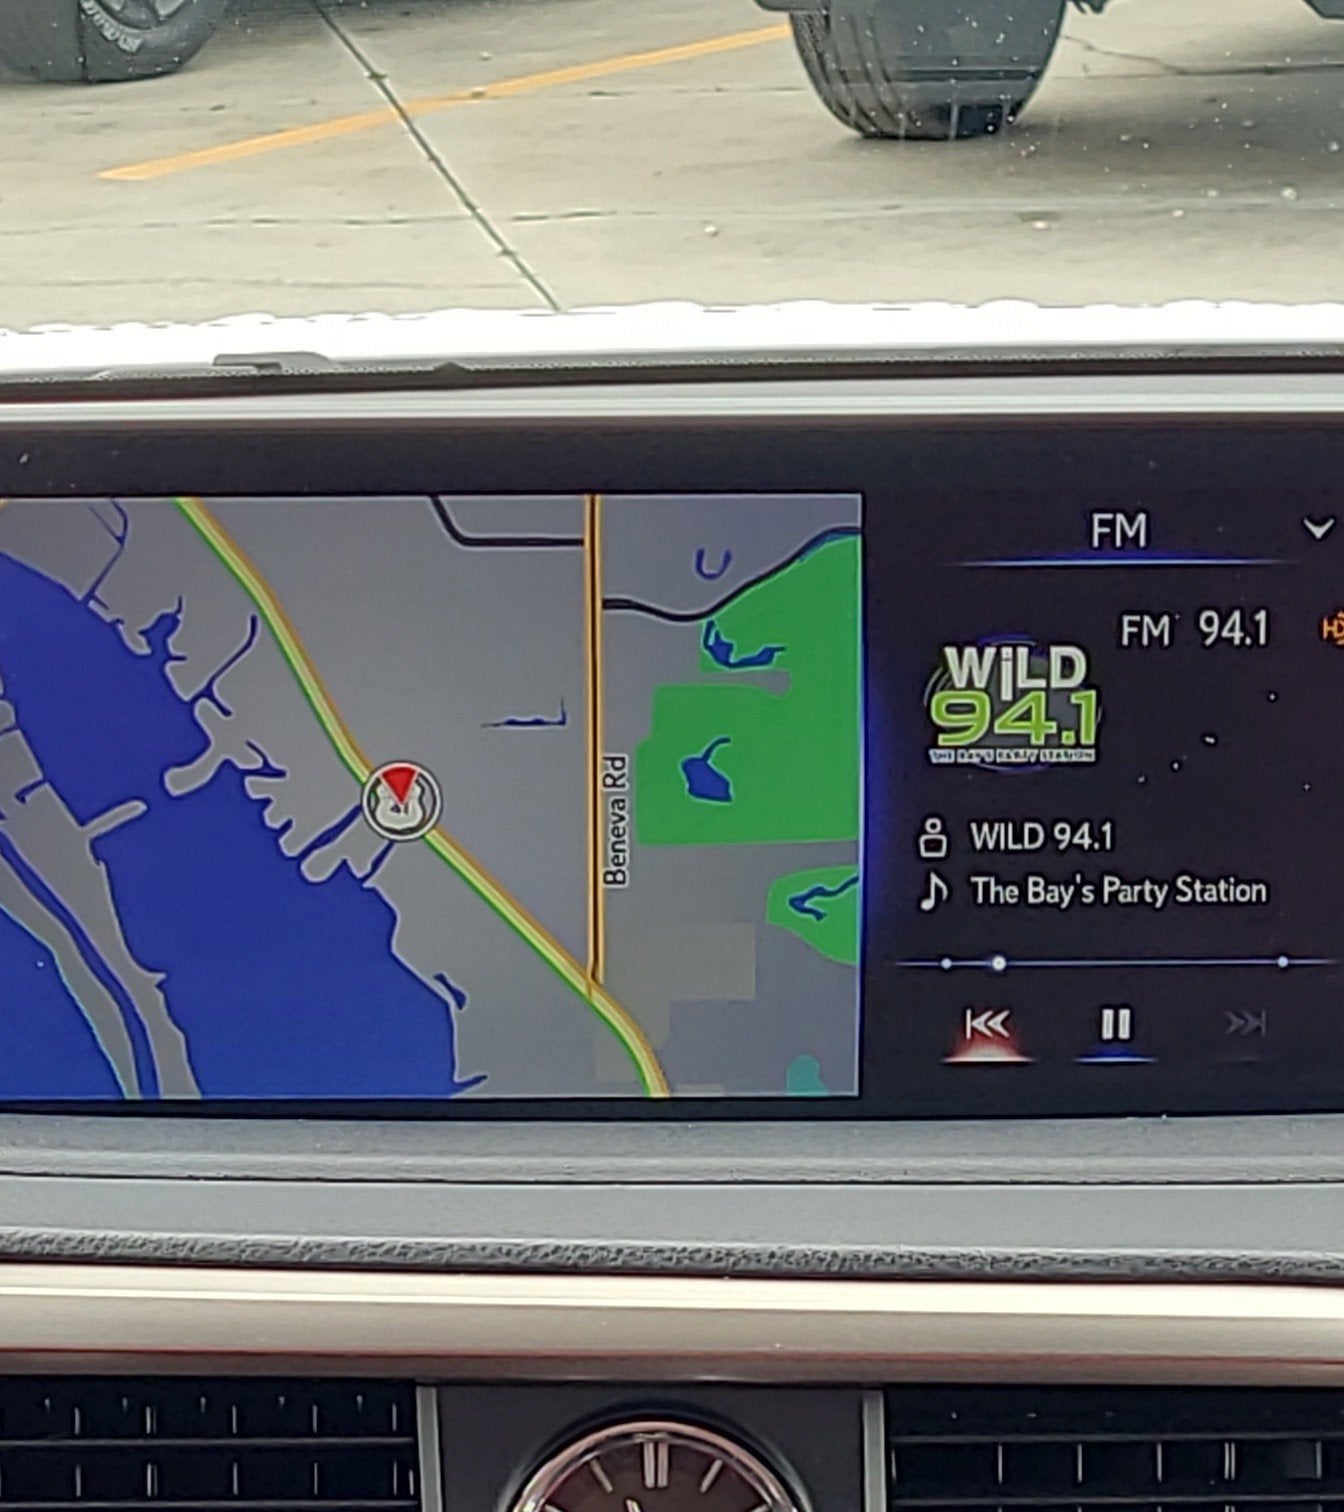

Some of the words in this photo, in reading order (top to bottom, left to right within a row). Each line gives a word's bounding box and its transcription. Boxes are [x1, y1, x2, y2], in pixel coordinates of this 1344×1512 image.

[1092, 512, 1147, 549] FM
[1121, 614, 1170, 646] FM
[1199, 609, 1267, 646] 94.1
[931, 690, 1097, 746] 94.1
[602, 756, 627, 789] Rd
[602, 798, 627, 886] Beneva
[970, 822, 1045, 851] WILD
[1053, 821, 1112, 850] 94.1
[970, 876, 1019, 904] The
[1027, 873, 1095, 909] Bay's
[1103, 875, 1169, 909] Party
[1175, 875, 1267, 903] Station
